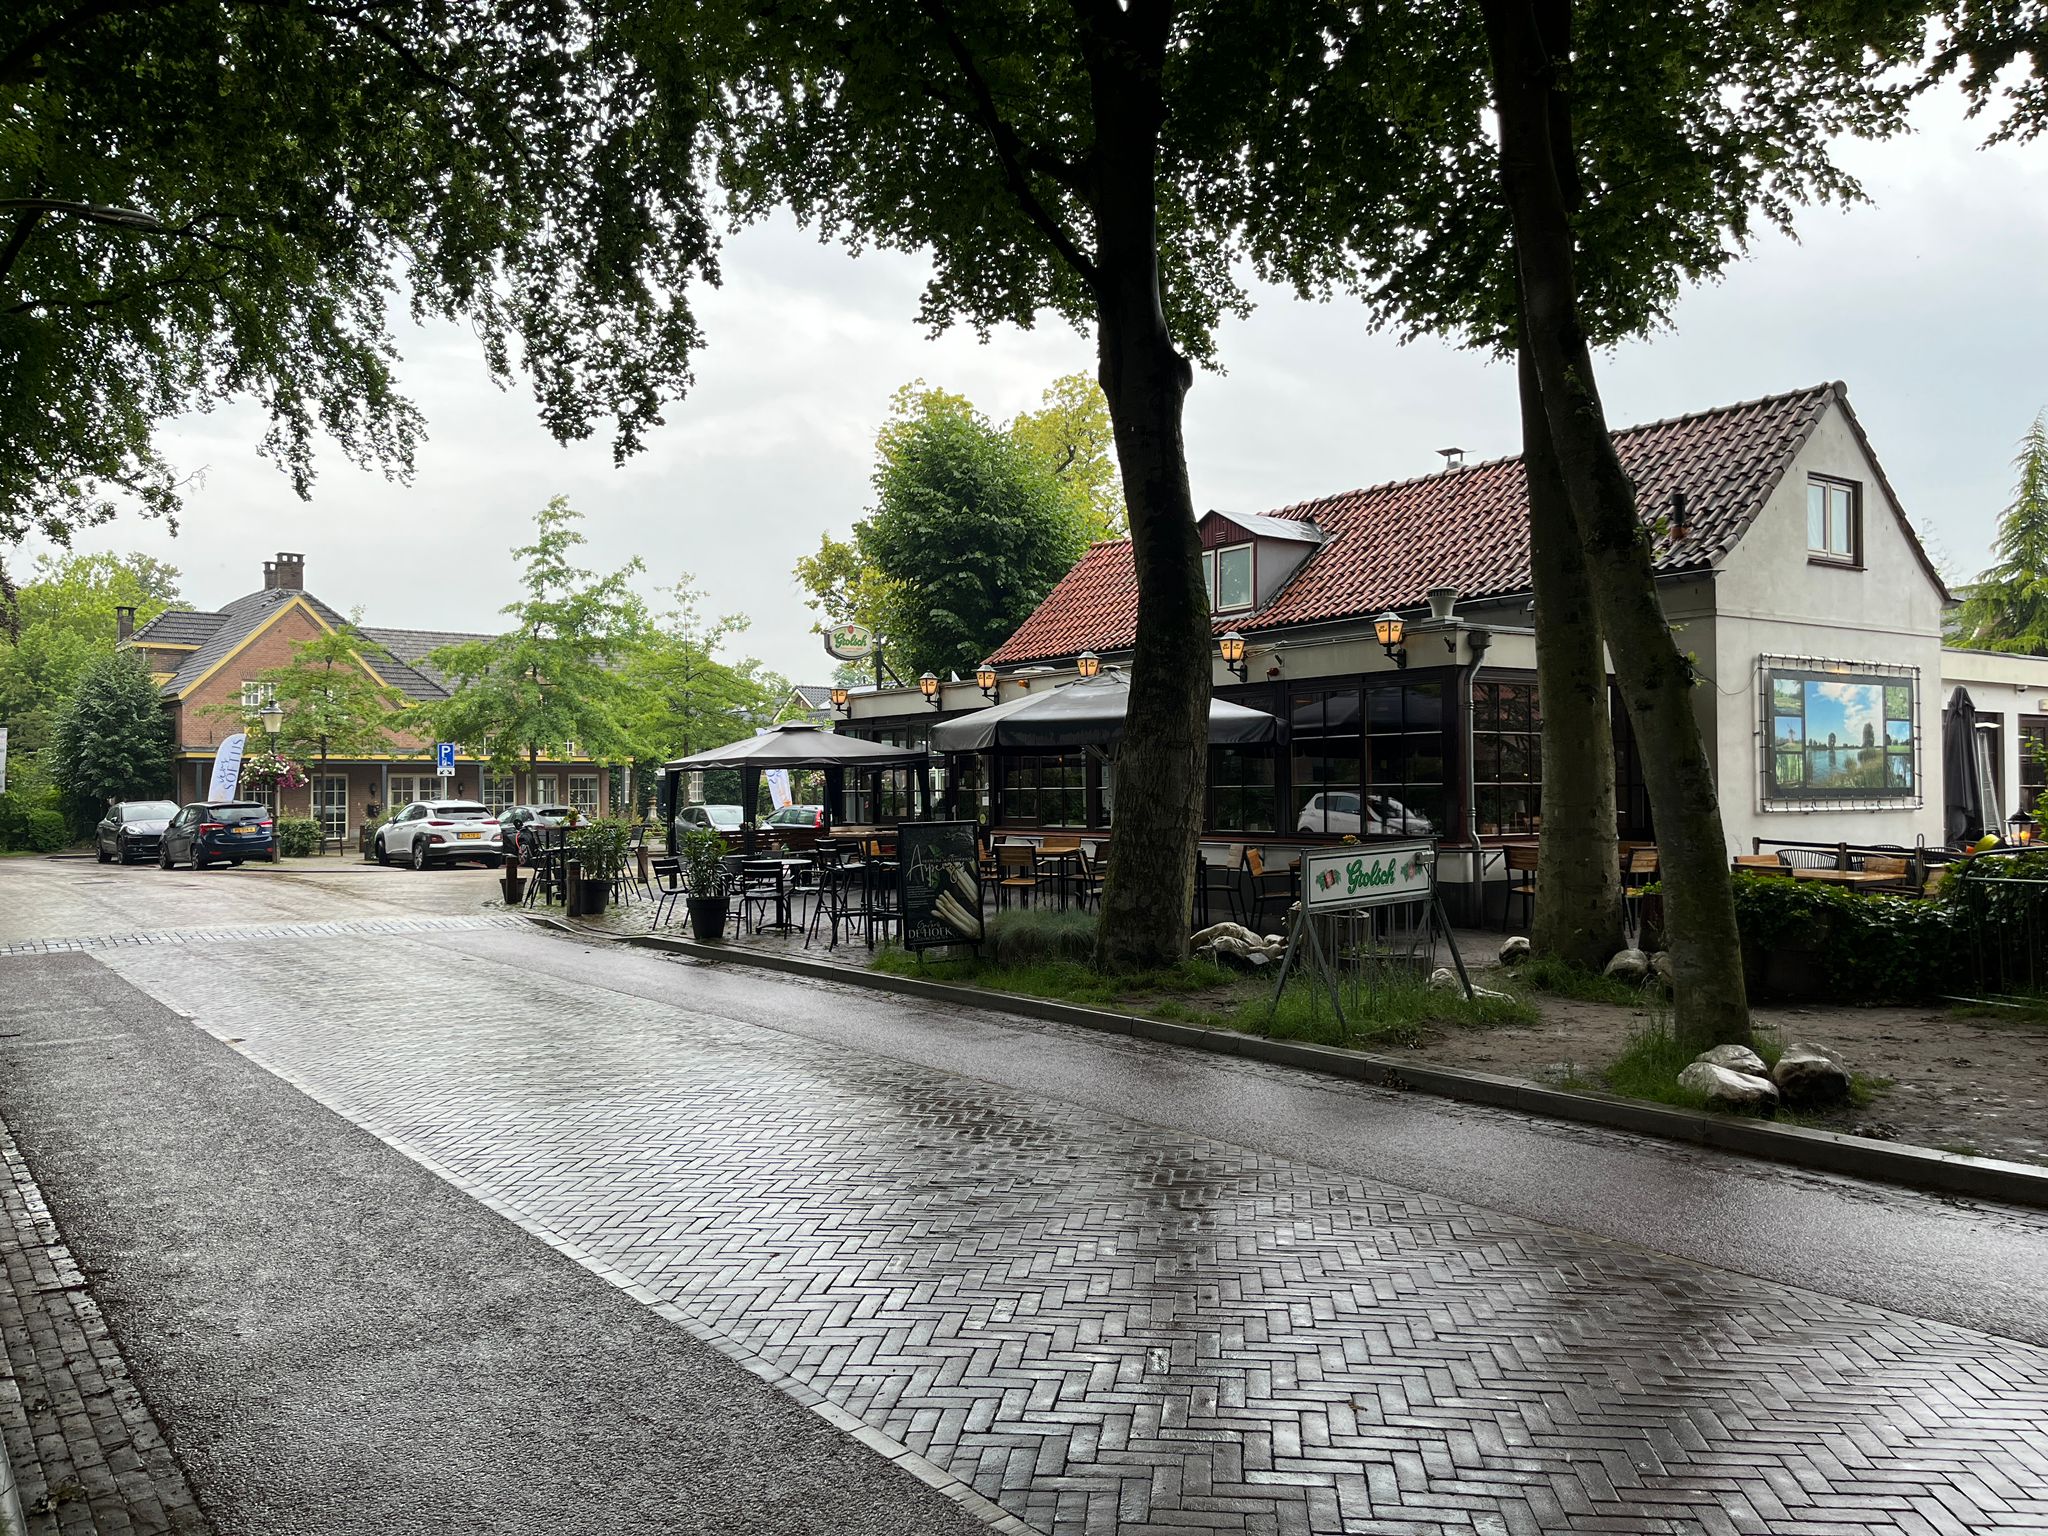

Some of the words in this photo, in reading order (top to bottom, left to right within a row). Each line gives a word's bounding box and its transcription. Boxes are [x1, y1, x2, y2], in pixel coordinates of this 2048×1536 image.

[834, 633, 867, 648] Grolsch
[441, 745, 451, 758] P
[1346, 858, 1396, 894] Grolsch
